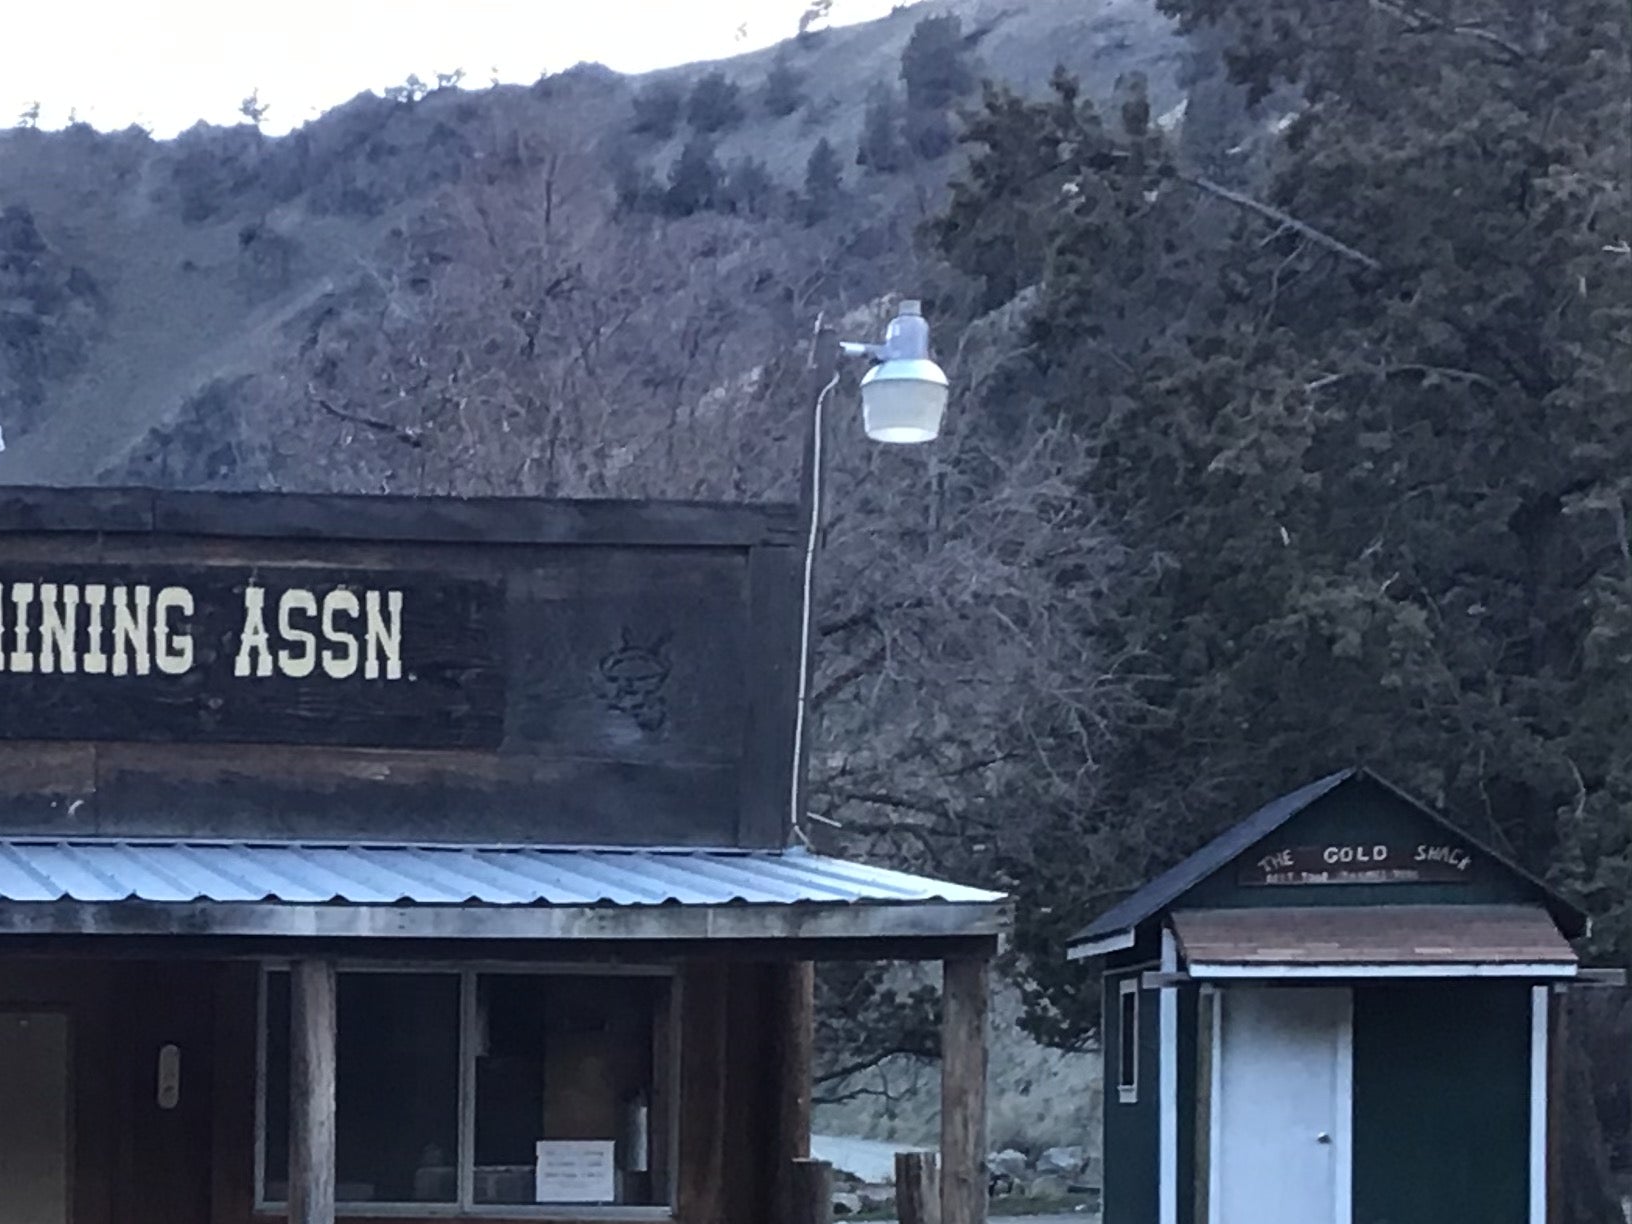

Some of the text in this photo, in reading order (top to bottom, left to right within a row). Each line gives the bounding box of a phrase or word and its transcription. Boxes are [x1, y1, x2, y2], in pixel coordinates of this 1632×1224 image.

[1257, 845, 1471, 872] THE GOLD SHACK
